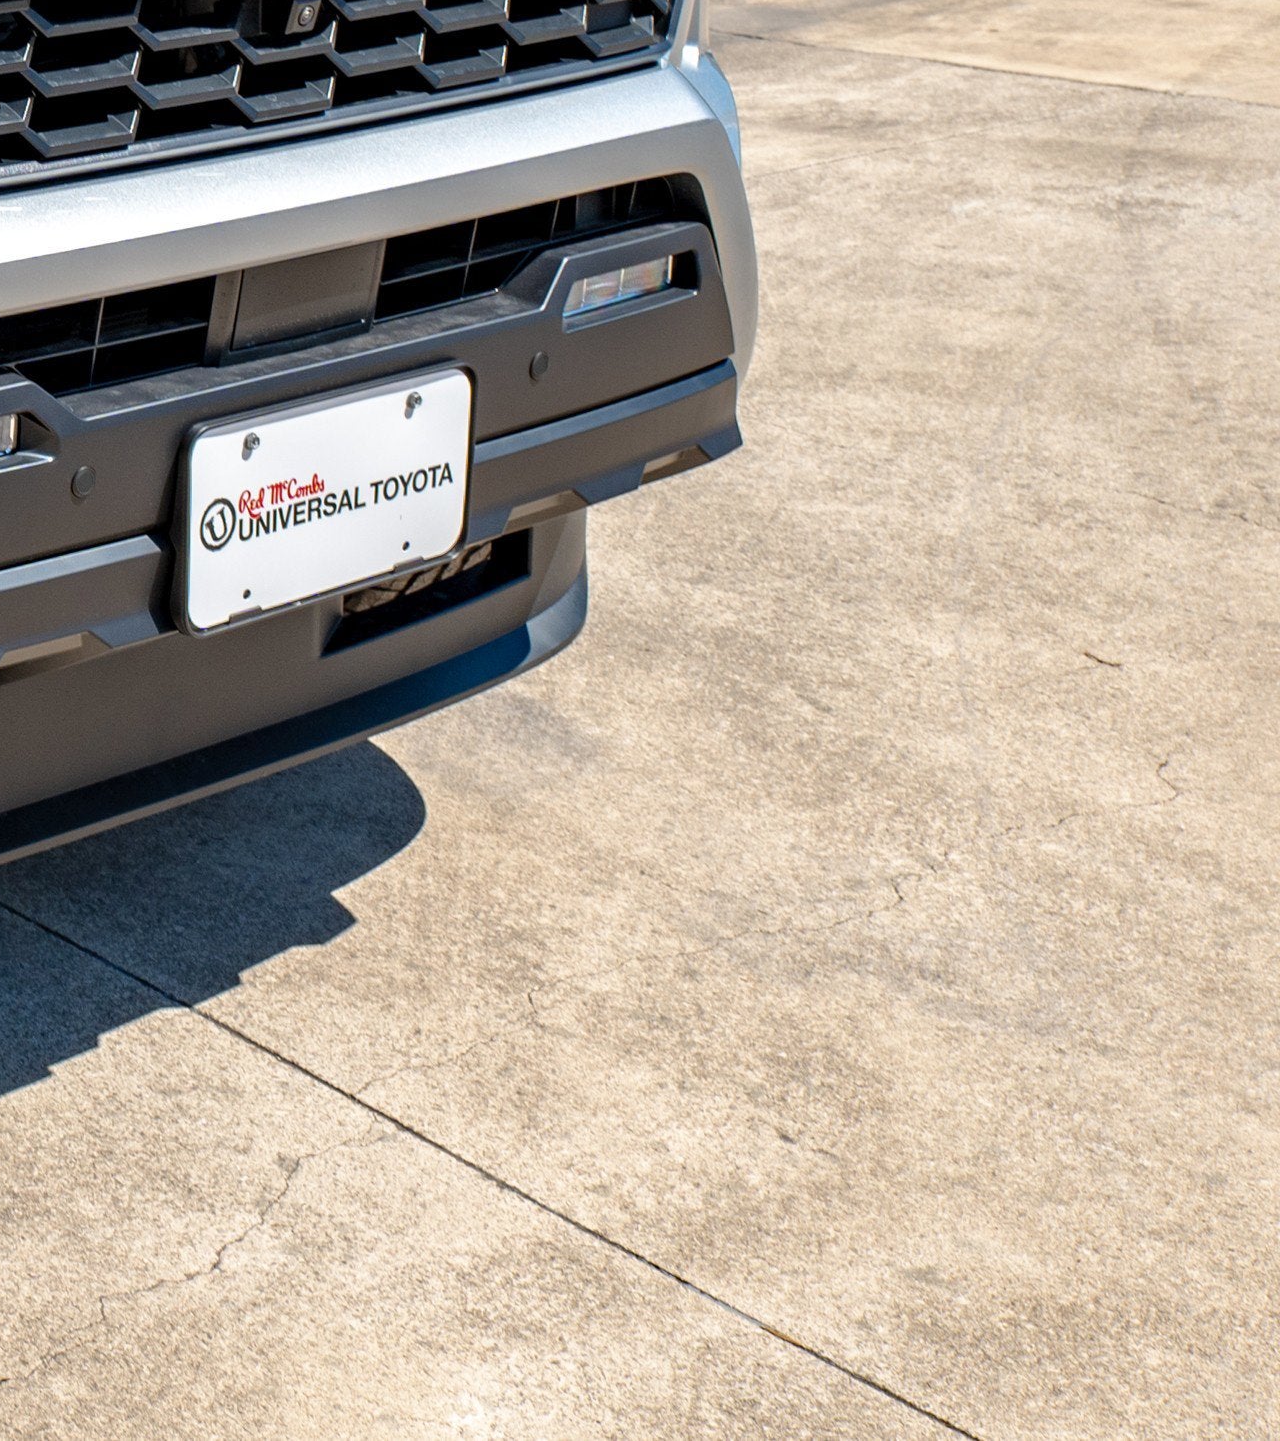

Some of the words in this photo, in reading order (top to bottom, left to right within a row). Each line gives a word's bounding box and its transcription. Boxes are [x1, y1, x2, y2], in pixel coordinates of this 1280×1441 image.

[238, 489, 264, 520] Red
[267, 473, 325, 505] McCombs
[238, 487, 366, 541] UNIVERSAL
[370, 462, 454, 504] TOYOTA
